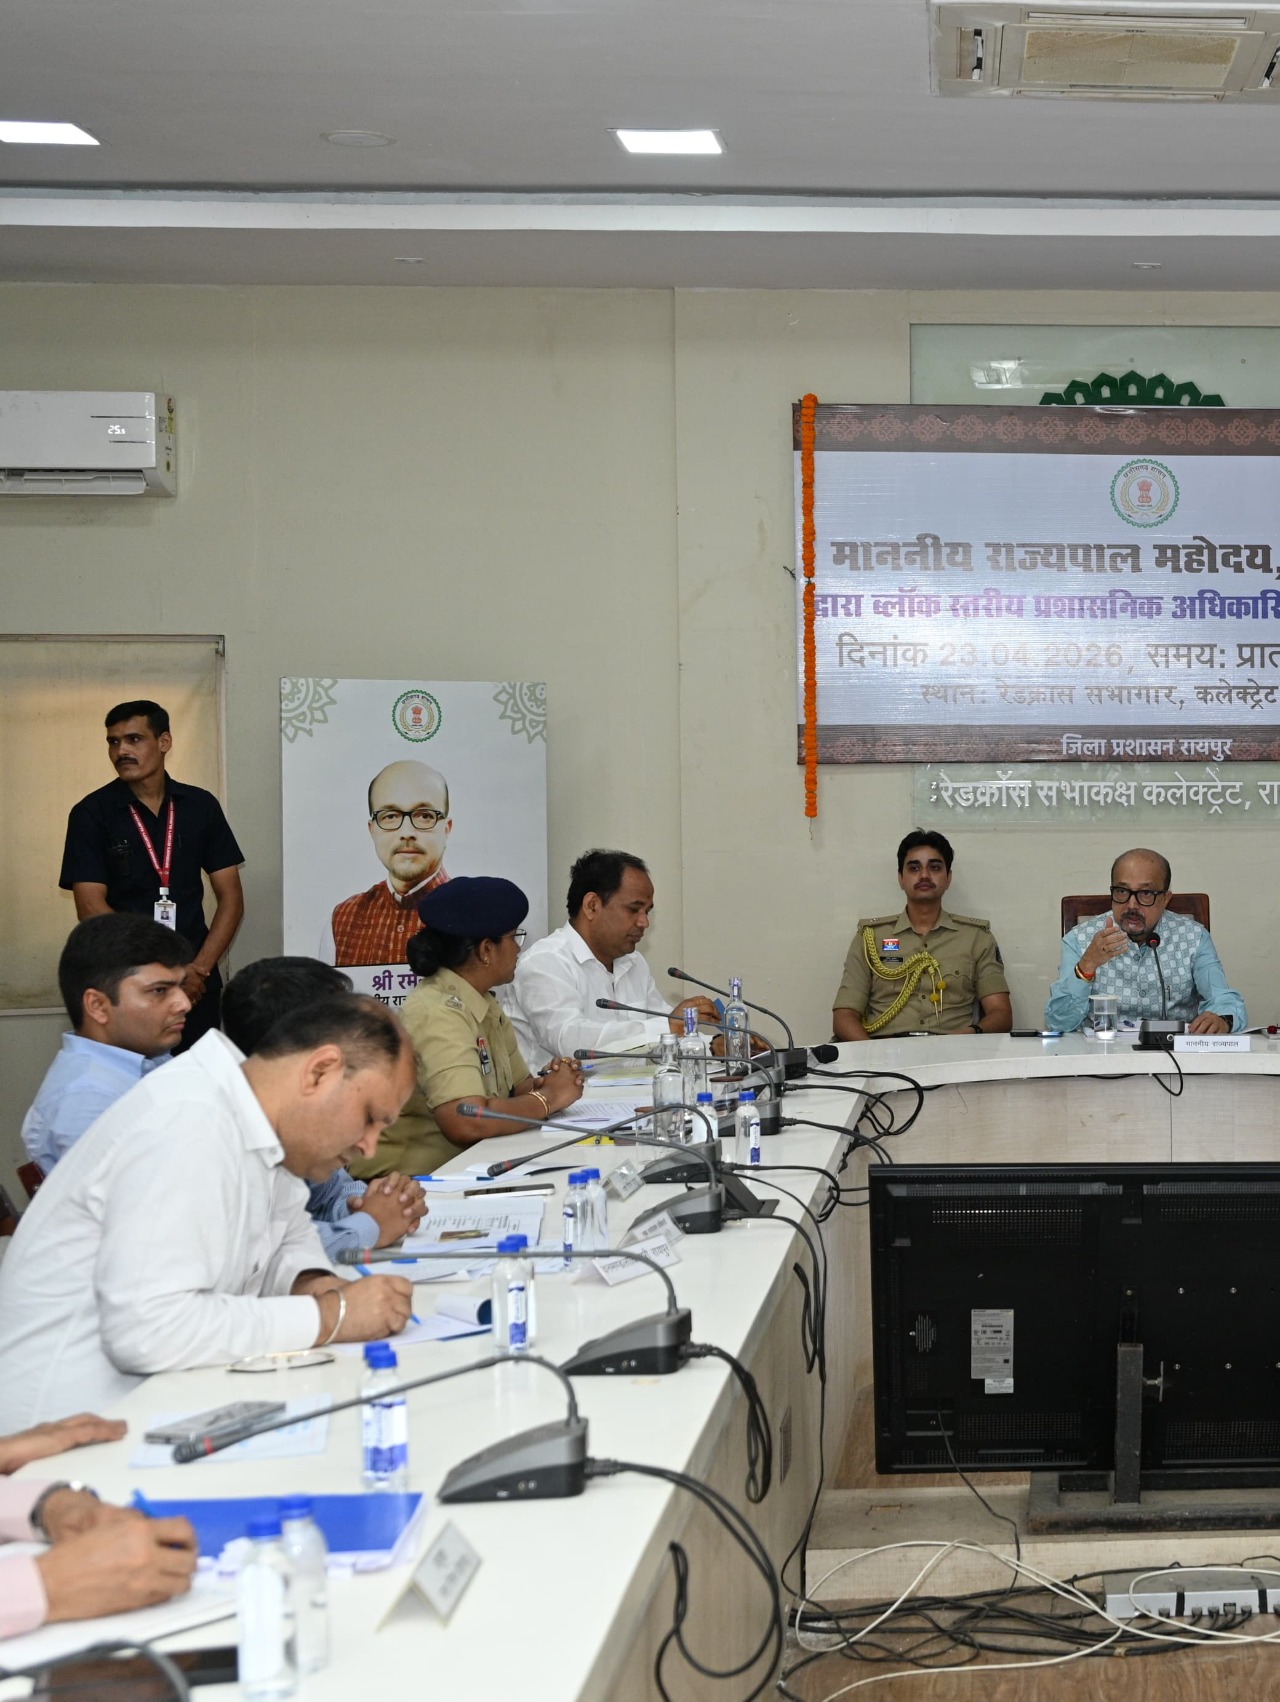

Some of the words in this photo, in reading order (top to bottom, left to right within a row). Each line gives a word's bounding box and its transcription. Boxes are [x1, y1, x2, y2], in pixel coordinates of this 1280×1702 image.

[830, 533, 974, 572] माननीय
[985, 542, 1142, 573] राज्यपाल
[871, 585, 942, 618] ब्लॉक
[948, 587, 1027, 619] स्तरीय
[1033, 588, 1163, 620] प्रशासनिक
[836, 632, 929, 669] दिनांक
[1146, 642, 1226, 669] समय:
[921, 684, 986, 706] स्थान:
[1085, 685, 1184, 710] सभागार,
[1061, 733, 1108, 756] जिला
[1112, 738, 1173, 757] प्रशासन
[1180, 738, 1233, 761] रायपुर
[939, 769, 1032, 808] रेडक्रॉस
[1035, 780, 1137, 807] सभाकक्ष
[1142, 769, 1252, 814] कलेक्ट्रेट,
[372, 969, 394, 991] श्री
